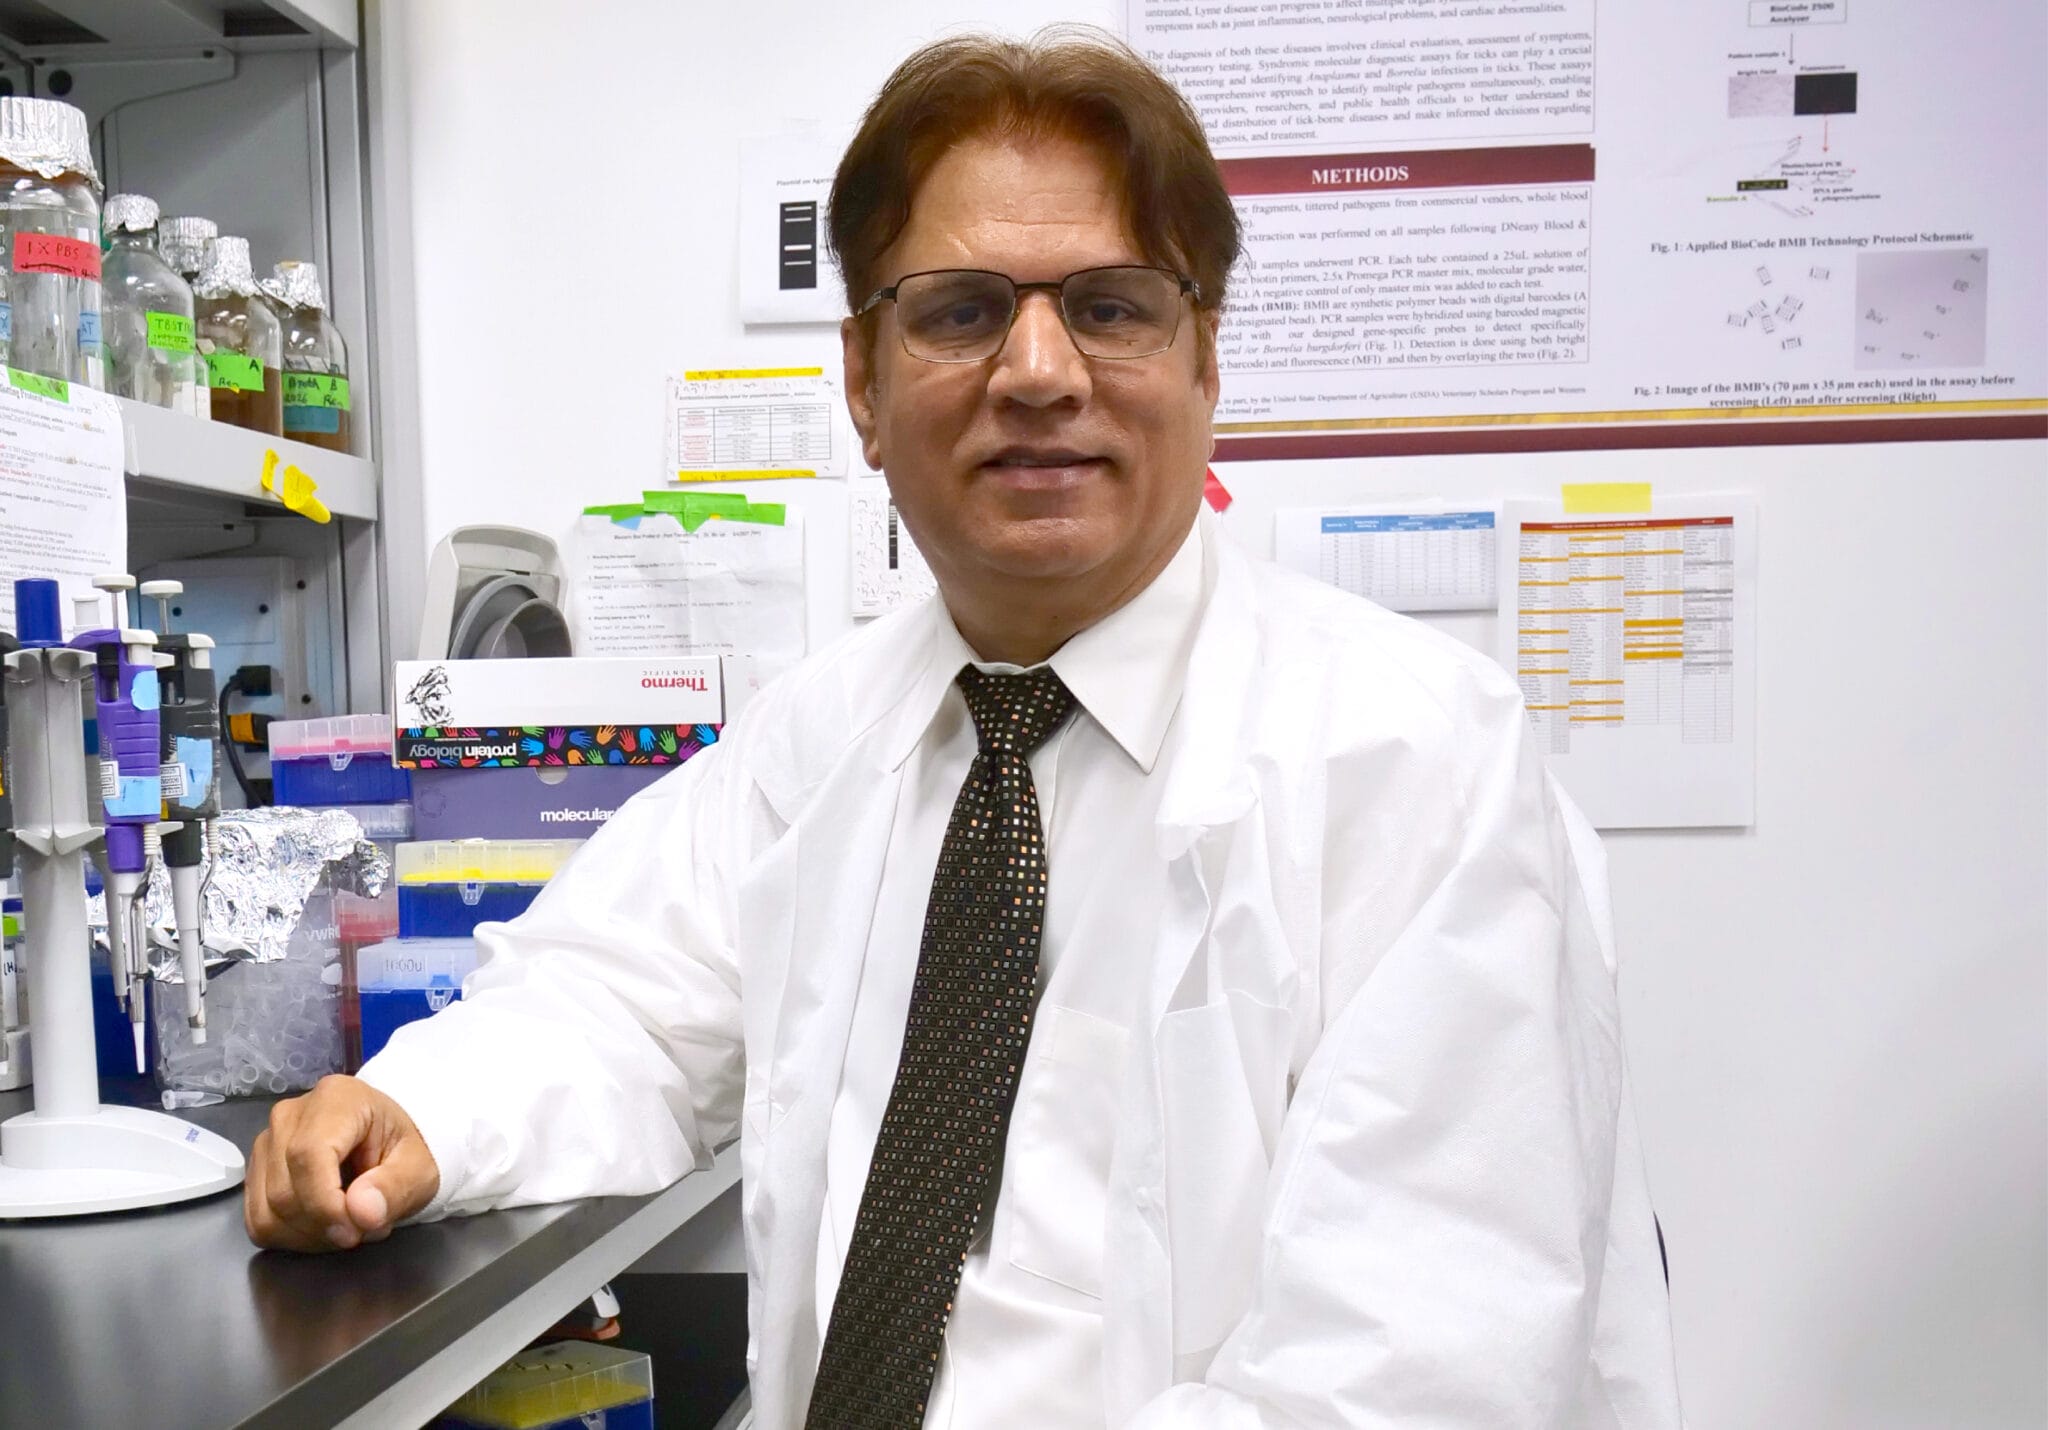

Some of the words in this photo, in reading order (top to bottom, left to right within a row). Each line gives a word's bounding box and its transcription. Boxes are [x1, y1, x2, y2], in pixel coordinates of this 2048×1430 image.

[1194, 88, 1266, 102] comprehensive
[1270, 86, 1313, 99] approach
[1318, 85, 1328, 95] to
[1331, 83, 1367, 96] identify
[1372, 81, 1412, 95] multiple
[1416, 79, 1466, 92] pathogens
[1548, 73, 1591, 87] enabling
[1198, 103, 1248, 117] providers,
[1254, 100, 1311, 114] researchers,
[1318, 99, 1336, 109] and
[1342, 97, 1372, 110] public
[1380, 96, 1410, 106] health
[1416, 93, 1456, 105] officials
[1463, 92, 1474, 103] to
[1480, 91, 1508, 102] better
[1515, 88, 1569, 100] understand
[1576, 87, 1592, 98] the
[1312, 166, 1409, 185] METHODS
[1252, 202, 1300, 216] fragments,
[1342, 198, 1390, 212] pathogens
[1394, 196, 1418, 207] from
[1420, 194, 1477, 206] commercial
[1482, 192, 1522, 205] vendors,
[1527, 190, 1555, 201] whole
[1560, 189, 1588, 200] blood
[1247, 230, 1294, 241] extraction
[1298, 232, 1317, 240] was
[1320, 227, 1370, 241] performed
[1391, 225, 1403, 236] all
[1407, 224, 1445, 237] samples
[1450, 222, 1496, 235] following
[1500, 220, 1538, 233] DNeasy
[1544, 218, 1574, 229] Blood
[1578, 218, 1586, 228] &
[1650, 242, 1671, 255] Fig.
[1684, 240, 1728, 253] Applied
[1730, 238, 1776, 249] BioCode
[1778, 237, 1807, 248] BMB
[1808, 235, 1870, 248] Technology
[1872, 233, 1918, 244] Protocol
[1918, 231, 1974, 242] Schematic
[1261, 258, 1300, 272] samples
[1303, 256, 1354, 268] underwent
[1358, 255, 1383, 266] PCR.
[1388, 254, 1412, 264] Each
[1416, 253, 1438, 263] tube
[1441, 251, 1489, 262] contained
[1532, 247, 1572, 258] solution
[1576, 246, 1588, 257] of
[1248, 273, 1278, 284] biotin
[1280, 272, 1319, 285] primers,
[1346, 269, 1388, 282] Promega
[1391, 268, 1413, 278] PCR
[1416, 266, 1448, 277] master
[1451, 265, 1473, 278] mix,
[1476, 264, 1524, 275] molecular
[1527, 262, 1554, 275] grade
[1557, 261, 1586, 274] water,
[1303, 299, 1329, 310] BMB
[1332, 301, 1346, 309] are
[1350, 297, 1392, 310] synthetic
[1396, 295, 1435, 308] polymer
[1438, 294, 1466, 305] beads
[1470, 293, 1490, 304] with
[1494, 292, 1524, 305] digital
[1528, 290, 1570, 301] barcodes
[1574, 289, 1586, 302] (A
[1235, 316, 1286, 329] designated
[1288, 314, 1316, 327] bead).
[1320, 313, 1342, 324] PCR
[1345, 312, 1383, 325] samples
[1412, 309, 1463, 322] hybridized
[1466, 307, 1492, 320] using
[1494, 306, 1539, 317] barcoded
[1541, 304, 1585, 317] magnetic
[1250, 330, 1271, 340] with
[1312, 327, 1354, 340] designed
[1362, 324, 1425, 338] gene-specific
[1434, 322, 1466, 336] probes
[1475, 321, 1484, 332] to
[1492, 320, 1521, 331] detect
[1530, 318, 1584, 332] specifically
[1222, 345, 1242, 356] and
[1364, 340, 1387, 352] (Fig.
[1392, 339, 1405, 352] 1).
[1409, 337, 1456, 348] Detection
[1460, 336, 1468, 347] is
[1472, 336, 1496, 346] done
[1499, 334, 1526, 348] using
[1530, 334, 1552, 344] both
[1556, 332, 1586, 345] bright
[1633, 385, 1652, 397] Fig.
[1665, 383, 1698, 396] Image
[1700, 383, 1713, 393] of
[1713, 382, 1731, 393] the
[1856, 377, 1887, 390] each)
[1888, 377, 1914, 387] used
[1916, 376, 1927, 386] in
[1928, 376, 1947, 386] the
[1948, 378, 1979, 388] assay
[1979, 374, 2015, 384] before
[1709, 395, 1759, 409] screening
[1760, 394, 1792, 407] (Left)
[1794, 394, 1814, 404] and
[1817, 393, 1842, 403] after
[1845, 391, 1895, 405] screening
[1898, 390, 1936, 403] (Right)
[641, 677, 708, 692] Thermo
[409, 744, 462, 760] biology
[464, 742, 517, 761] protein
[540, 807, 615, 822] molecular
